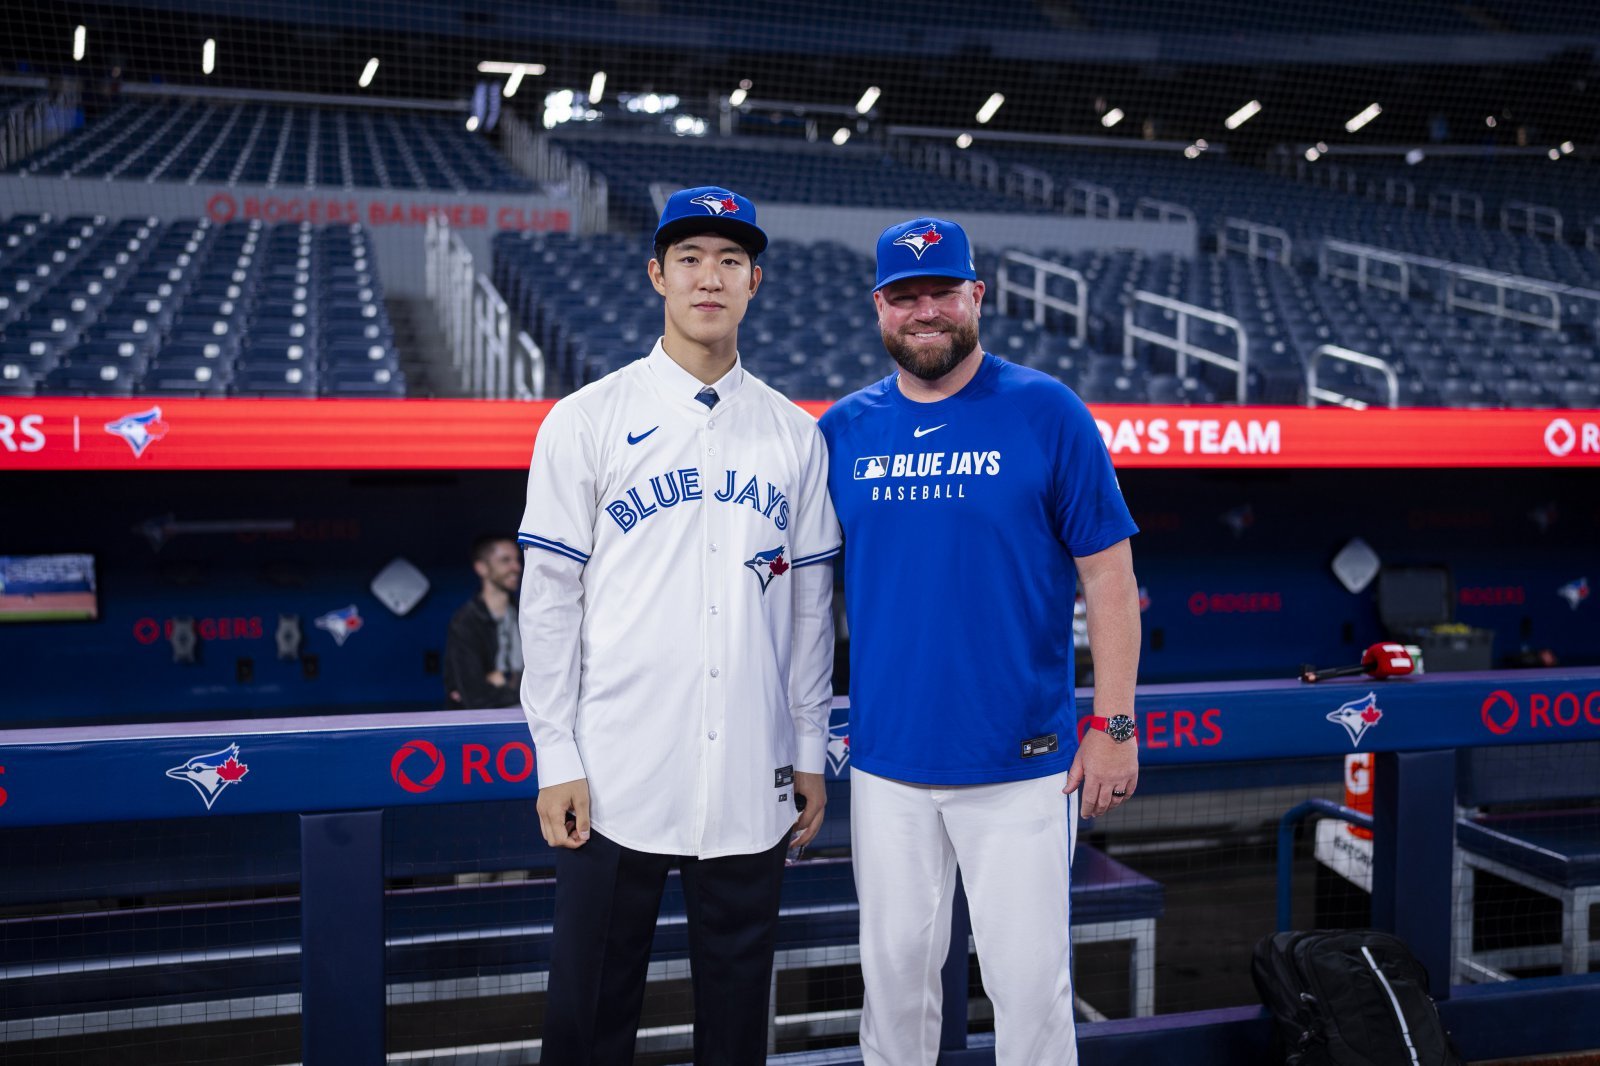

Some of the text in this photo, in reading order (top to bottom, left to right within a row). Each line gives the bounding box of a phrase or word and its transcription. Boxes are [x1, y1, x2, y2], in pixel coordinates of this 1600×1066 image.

[496, 207, 571, 233] CLUB
[1176, 419, 1281, 454] TEAM
[891, 450, 1001, 477] BLUE JAYS
[605, 467, 789, 534] BLUE JAYS
[872, 484, 965, 501] BASEBALL
[462, 741, 534, 785] RO
